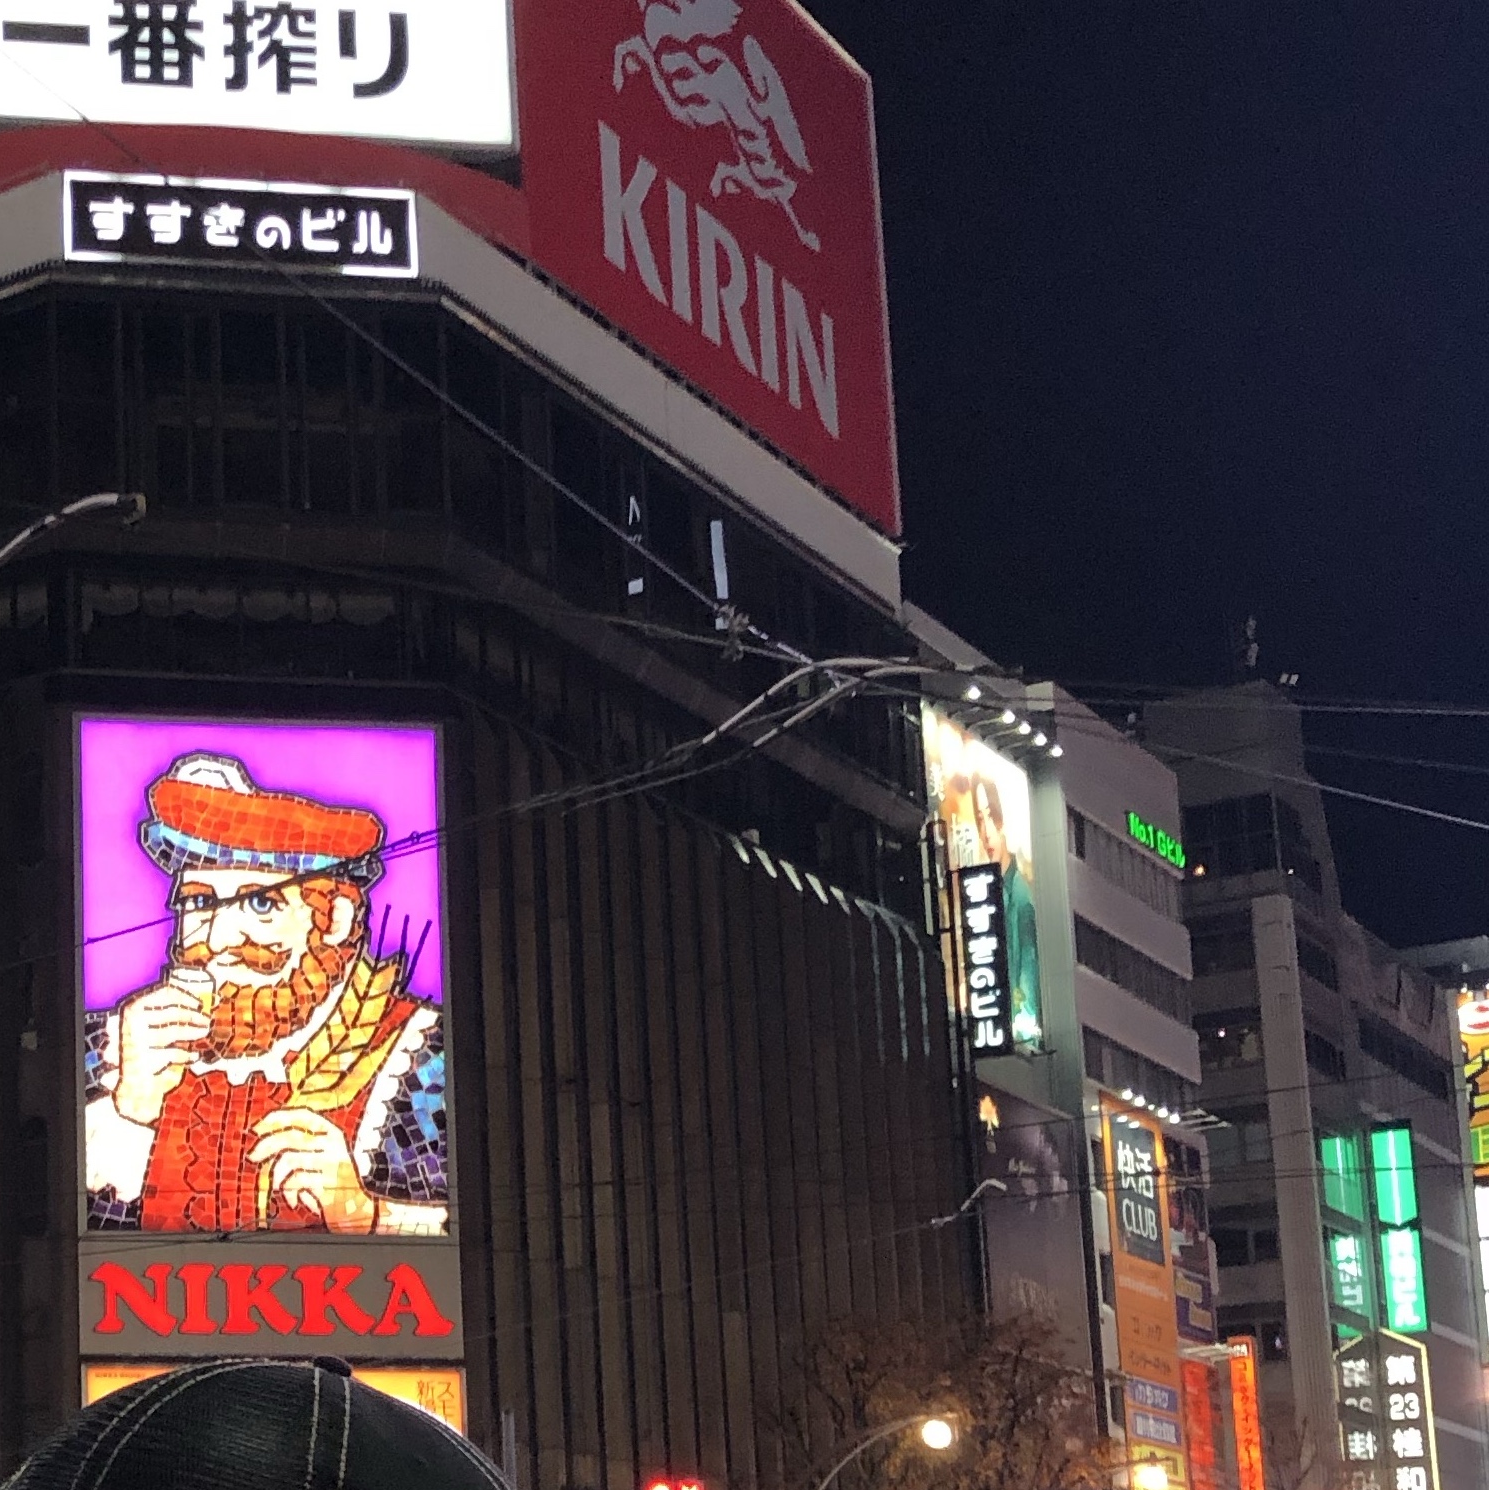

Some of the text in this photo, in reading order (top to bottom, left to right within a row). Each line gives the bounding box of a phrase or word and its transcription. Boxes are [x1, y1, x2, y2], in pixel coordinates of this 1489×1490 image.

[1, 0, 411, 99] 一番搾り
[87, 194, 393, 255] すすきのビル
[597, 118, 840, 441] KIRIN
[1128, 811, 1155, 849] No.1
[962, 871, 1005, 1050] すすきのビル
[1123, 1197, 1158, 1242] CLUB
[87, 1260, 456, 1339] NIKKA
